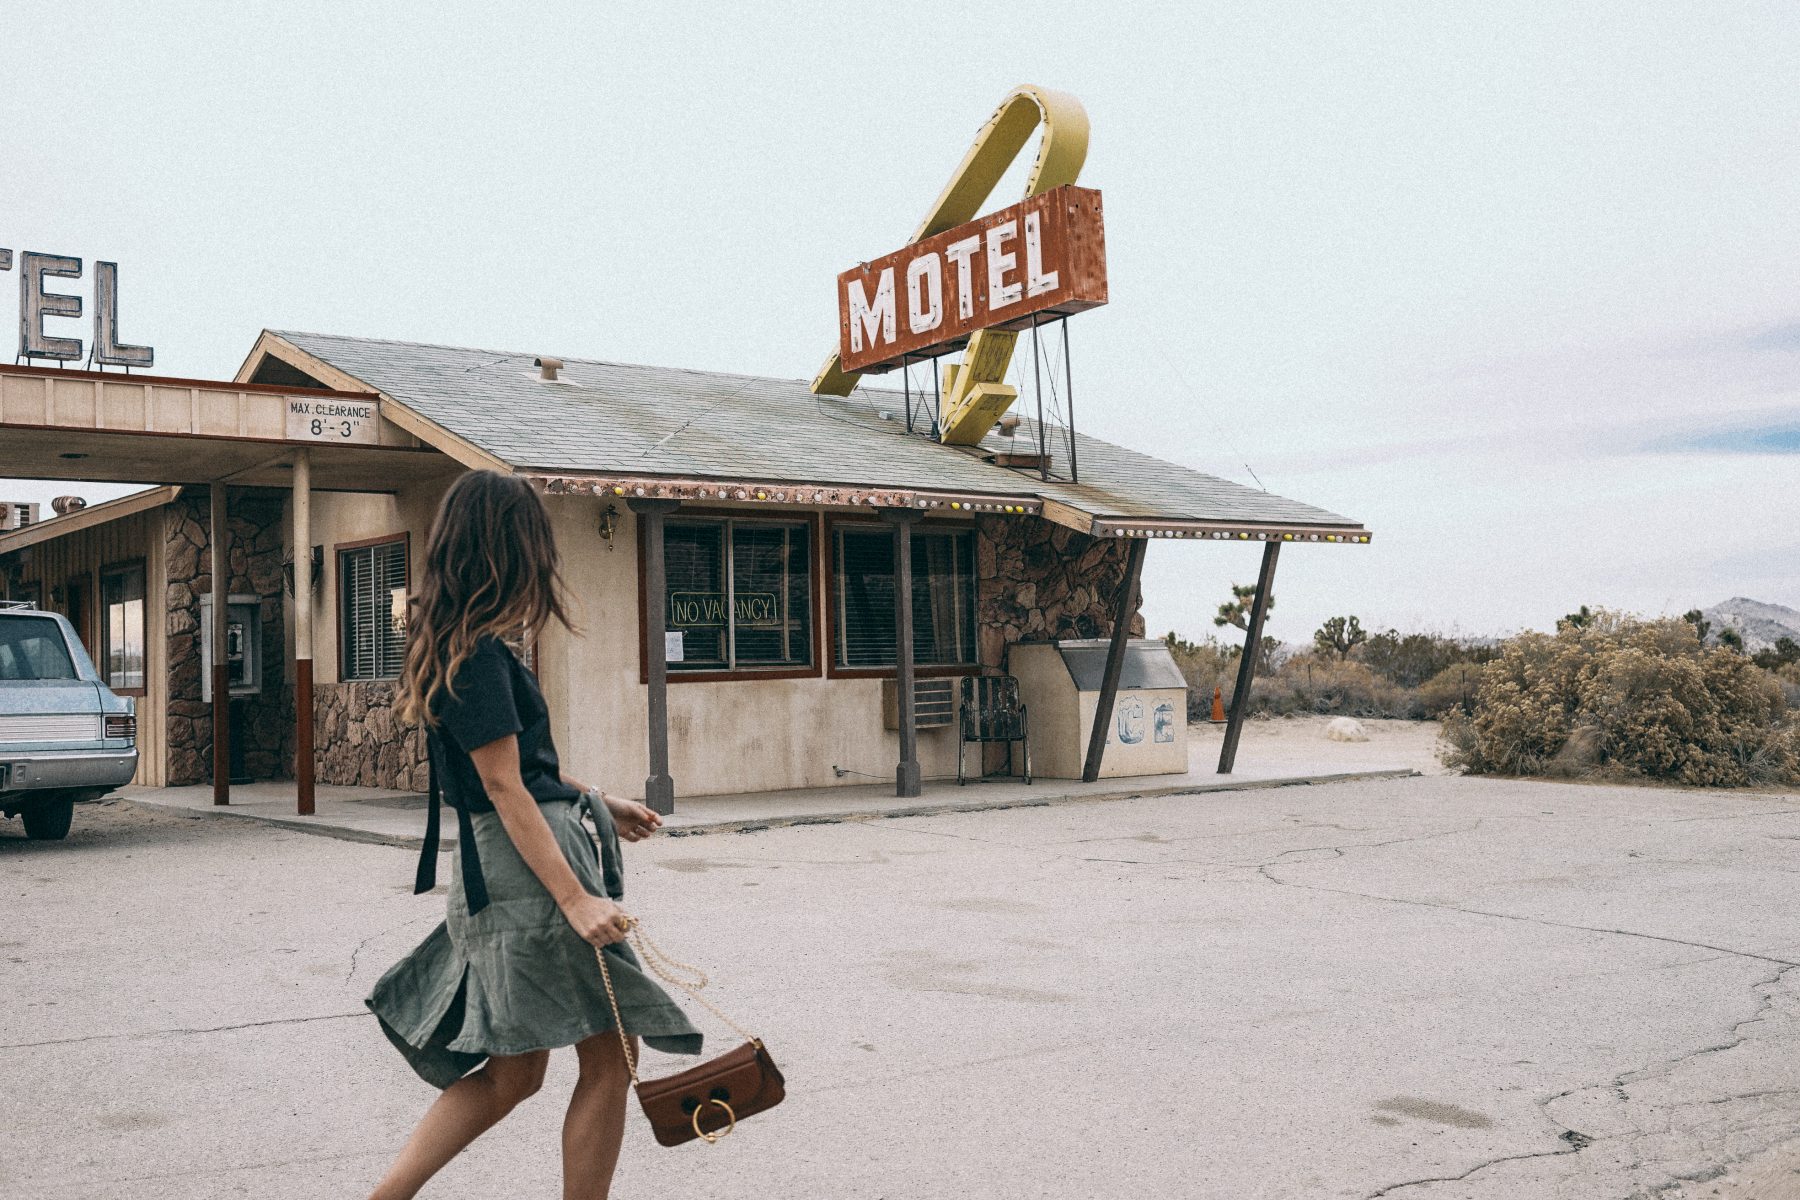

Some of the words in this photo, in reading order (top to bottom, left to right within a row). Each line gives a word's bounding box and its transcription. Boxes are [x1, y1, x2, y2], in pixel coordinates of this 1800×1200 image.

[0, 247, 154, 368] EL
[848, 210, 1060, 354] MOTEL
[290, 402, 314, 415] MAX.
[315, 404, 371, 419] CLEARANCE
[676, 601, 699, 622] NO
[1095, 694, 1175, 745] CE
